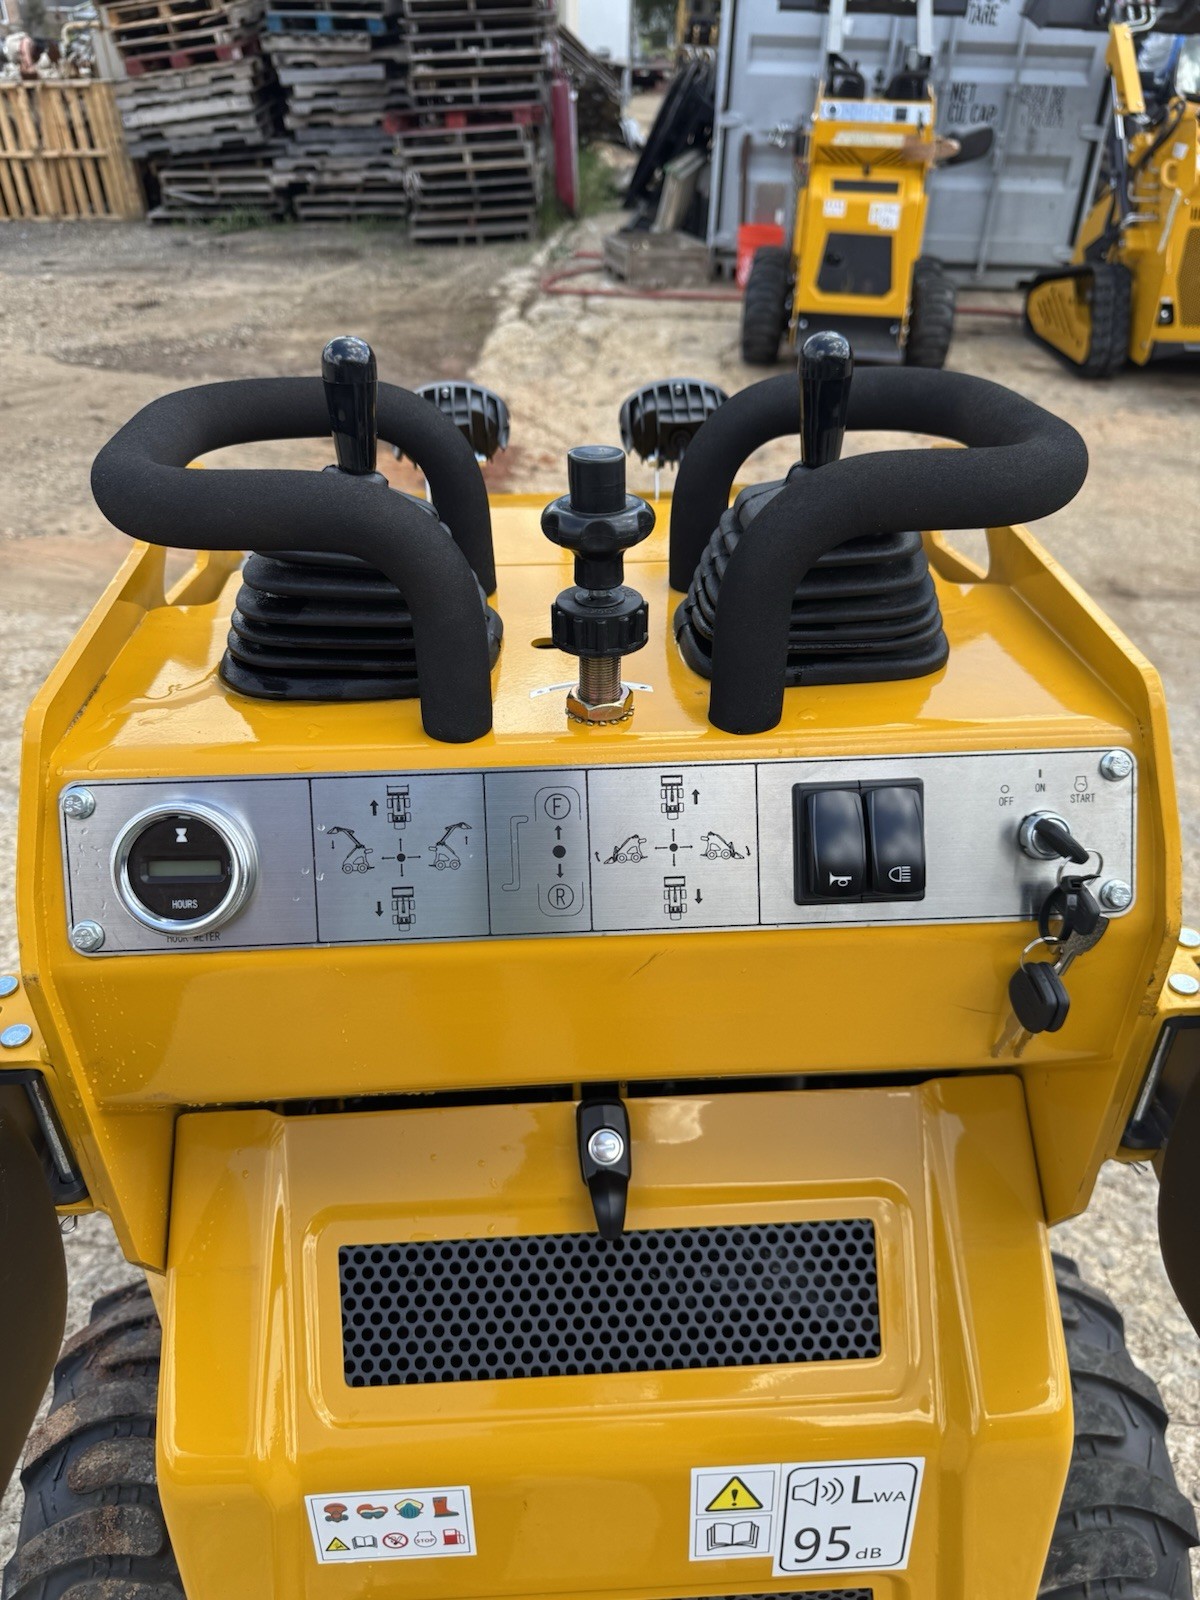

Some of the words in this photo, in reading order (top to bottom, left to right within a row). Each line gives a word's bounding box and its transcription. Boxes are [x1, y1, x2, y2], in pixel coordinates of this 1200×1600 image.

[968, 3, 999, 26] TARE
[949, 82, 977, 103] NET
[1035, 783, 1046, 793] ON
[998, 796, 1014, 807] OFF
[1070, 793, 1095, 803] START
[171, 899, 199, 910] HOURS
[794, 1525, 851, 1564] 95
[855, 1547, 882, 1560] dB
